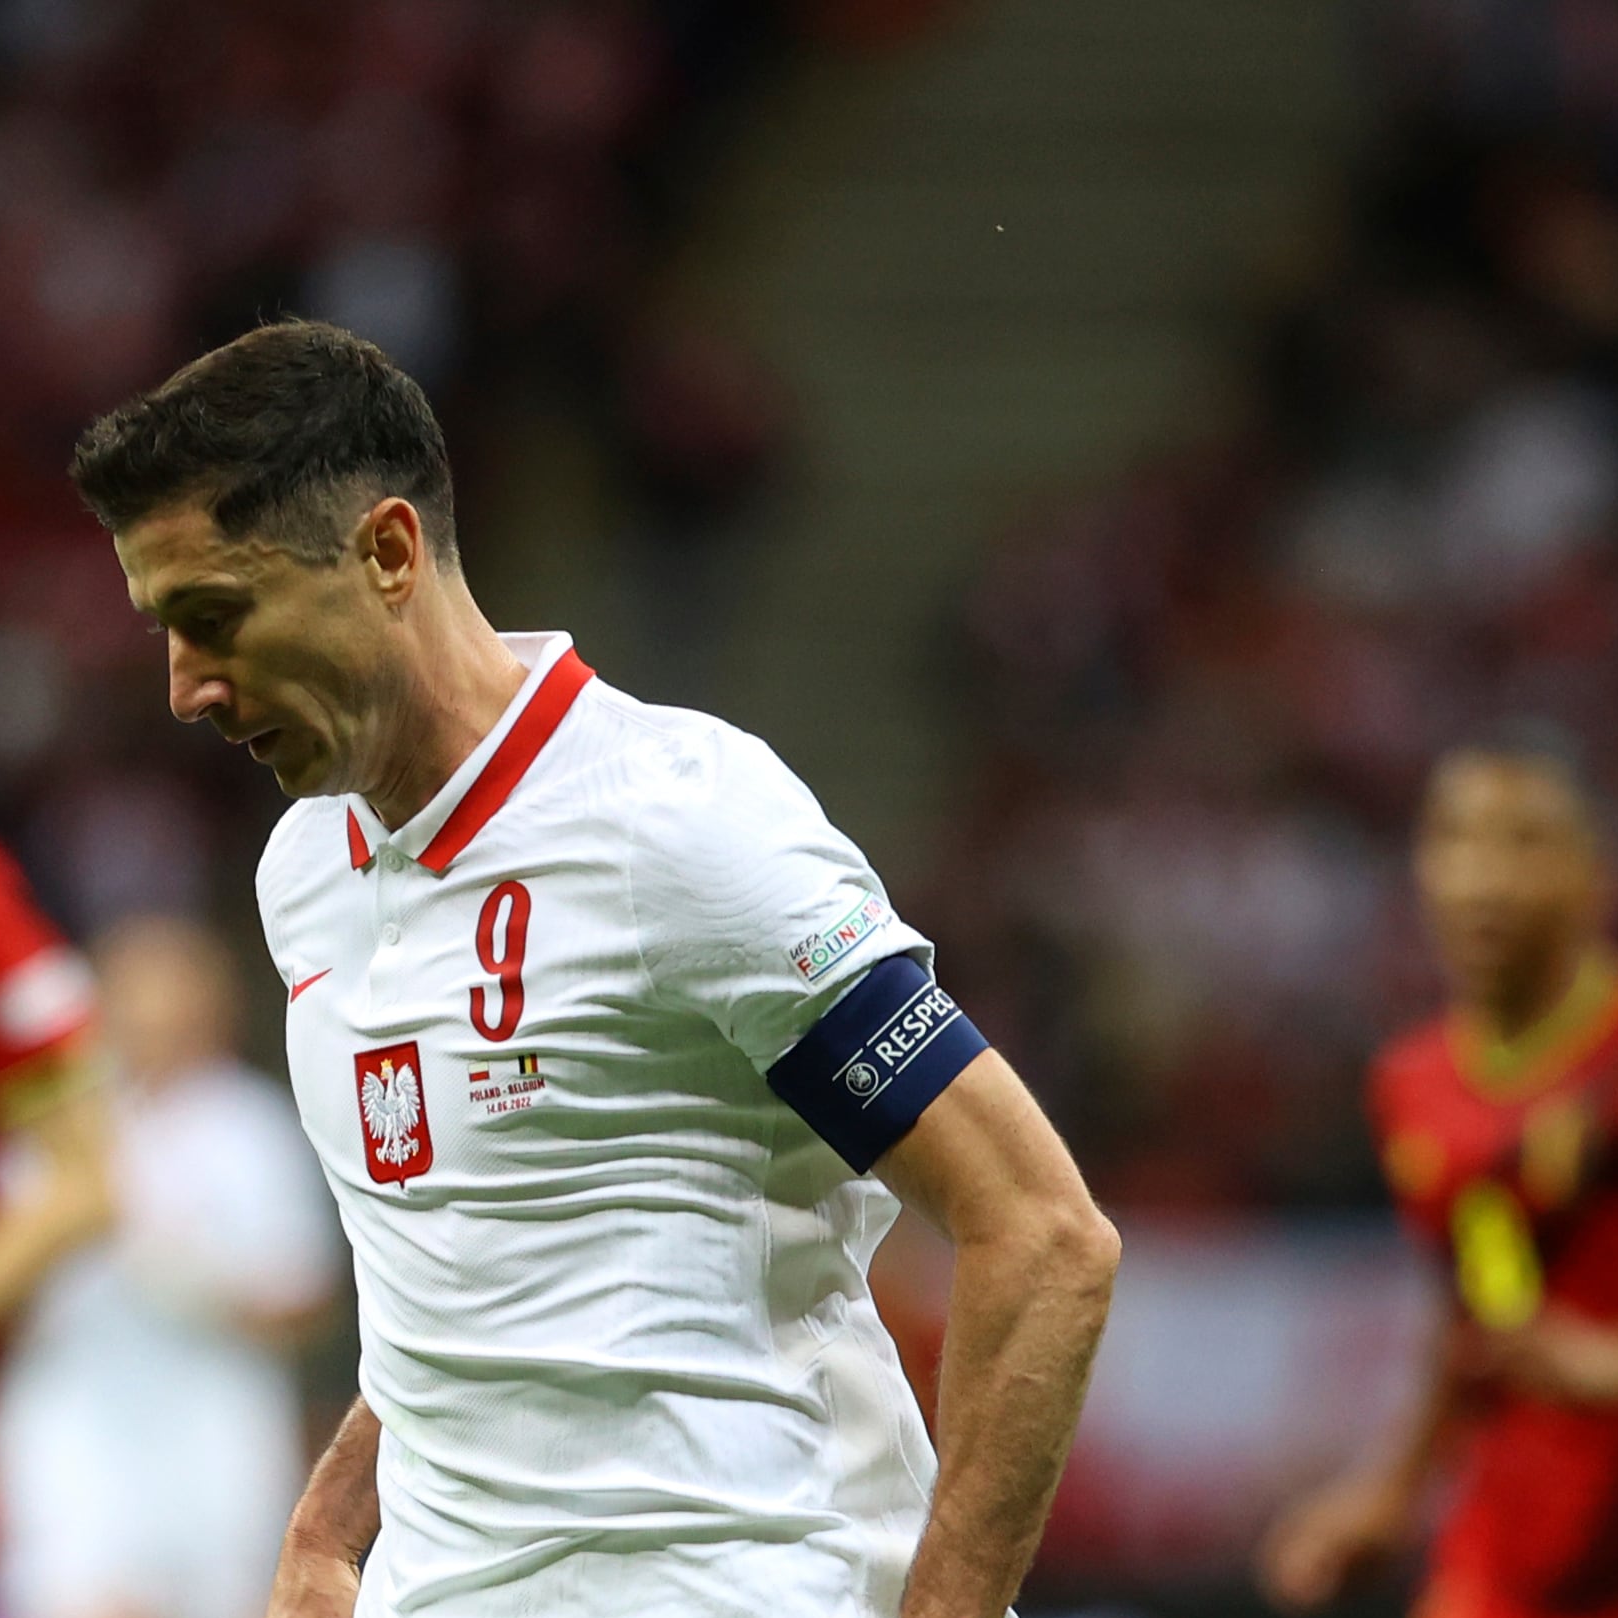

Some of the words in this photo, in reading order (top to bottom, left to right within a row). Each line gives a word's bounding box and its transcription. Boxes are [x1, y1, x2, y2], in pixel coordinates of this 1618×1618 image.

[470, 880, 531, 1042] 9
[790, 933, 821, 960] UEFA
[797, 897, 884, 977] FOUNDAT
[875, 988, 955, 1066] RESPEC
[470, 1087, 501, 1102] POLAND
[508, 1077, 545, 1095] BELGIUM
[486, 1097, 532, 1114] 14.06.2022
